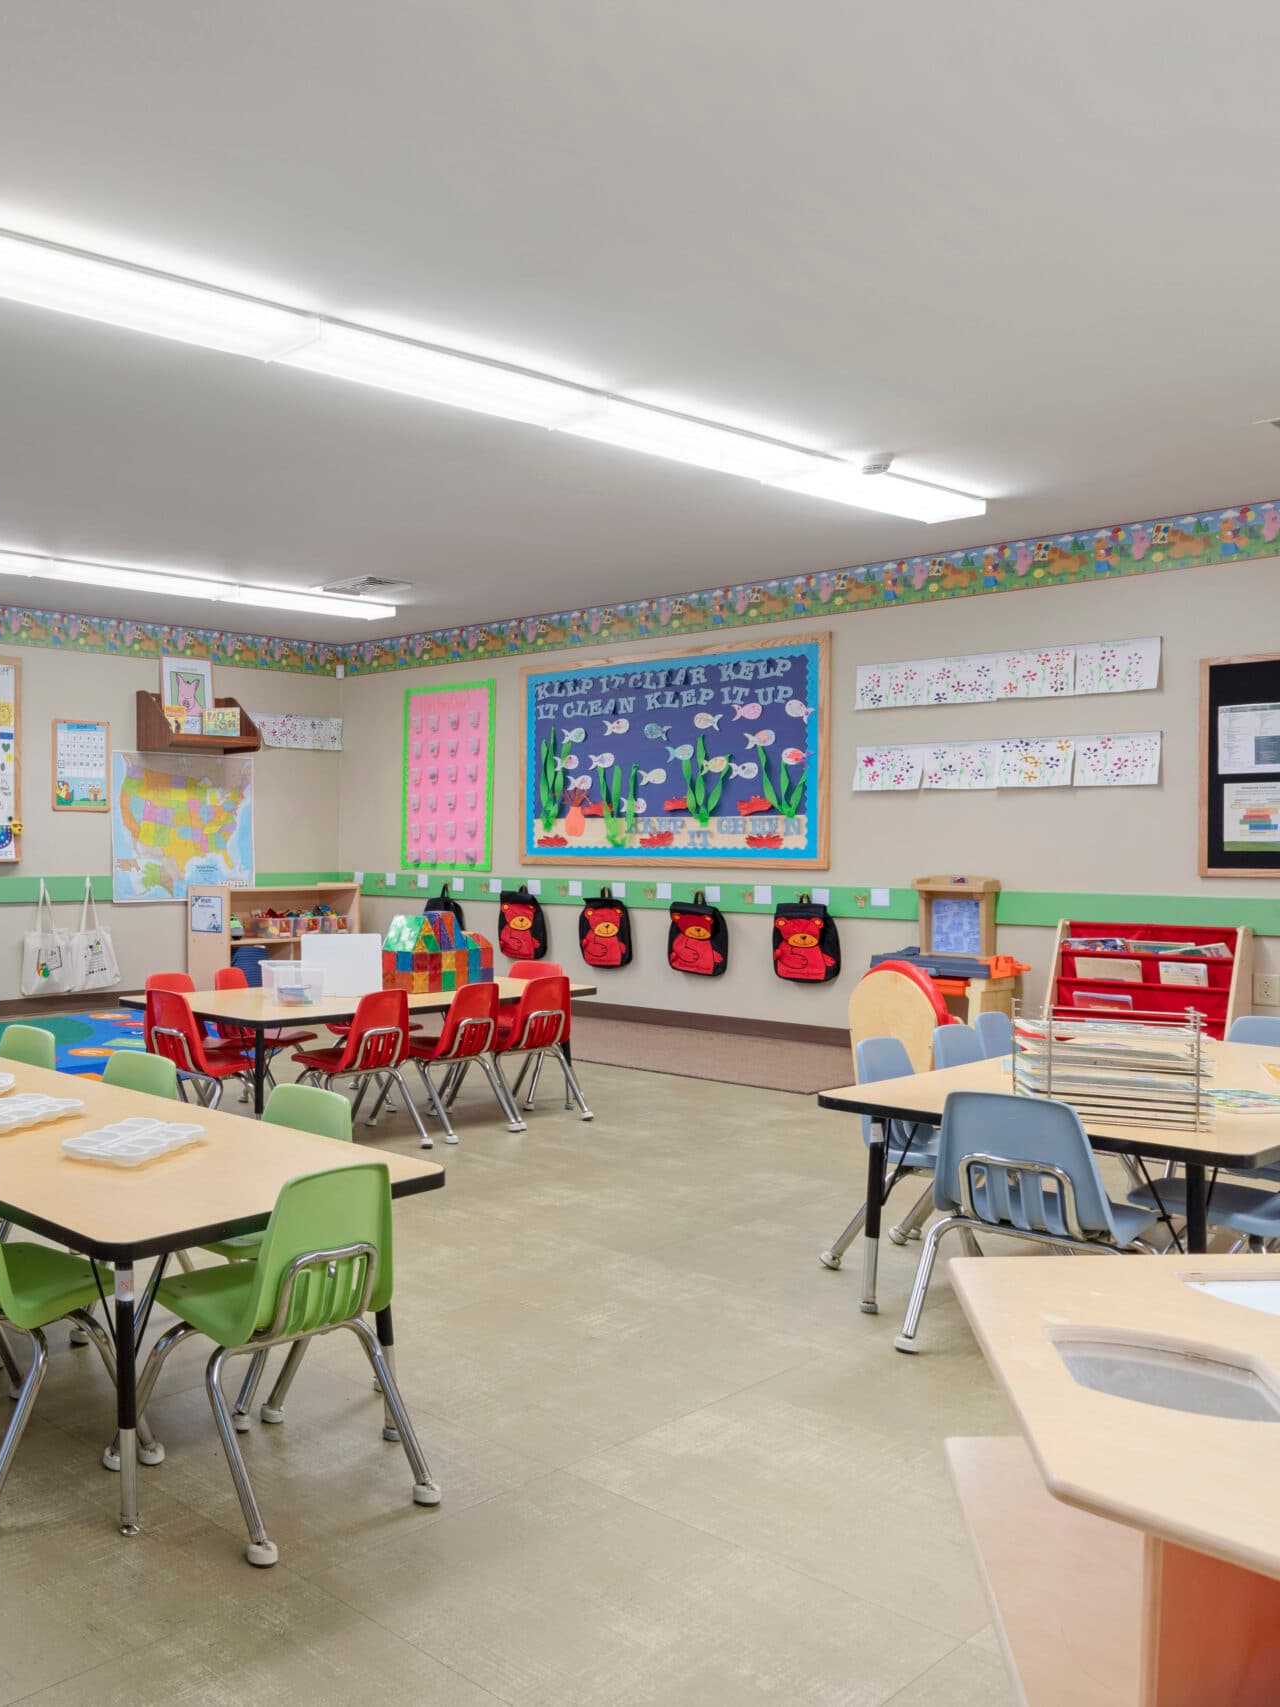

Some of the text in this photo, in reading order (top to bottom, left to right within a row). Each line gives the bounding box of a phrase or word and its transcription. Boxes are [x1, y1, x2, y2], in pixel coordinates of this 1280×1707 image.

[536, 703, 558, 720] IT
[562, 696, 636, 719] CLEAN
[721, 686, 750, 705] IT
[754, 685, 794, 706] UP
